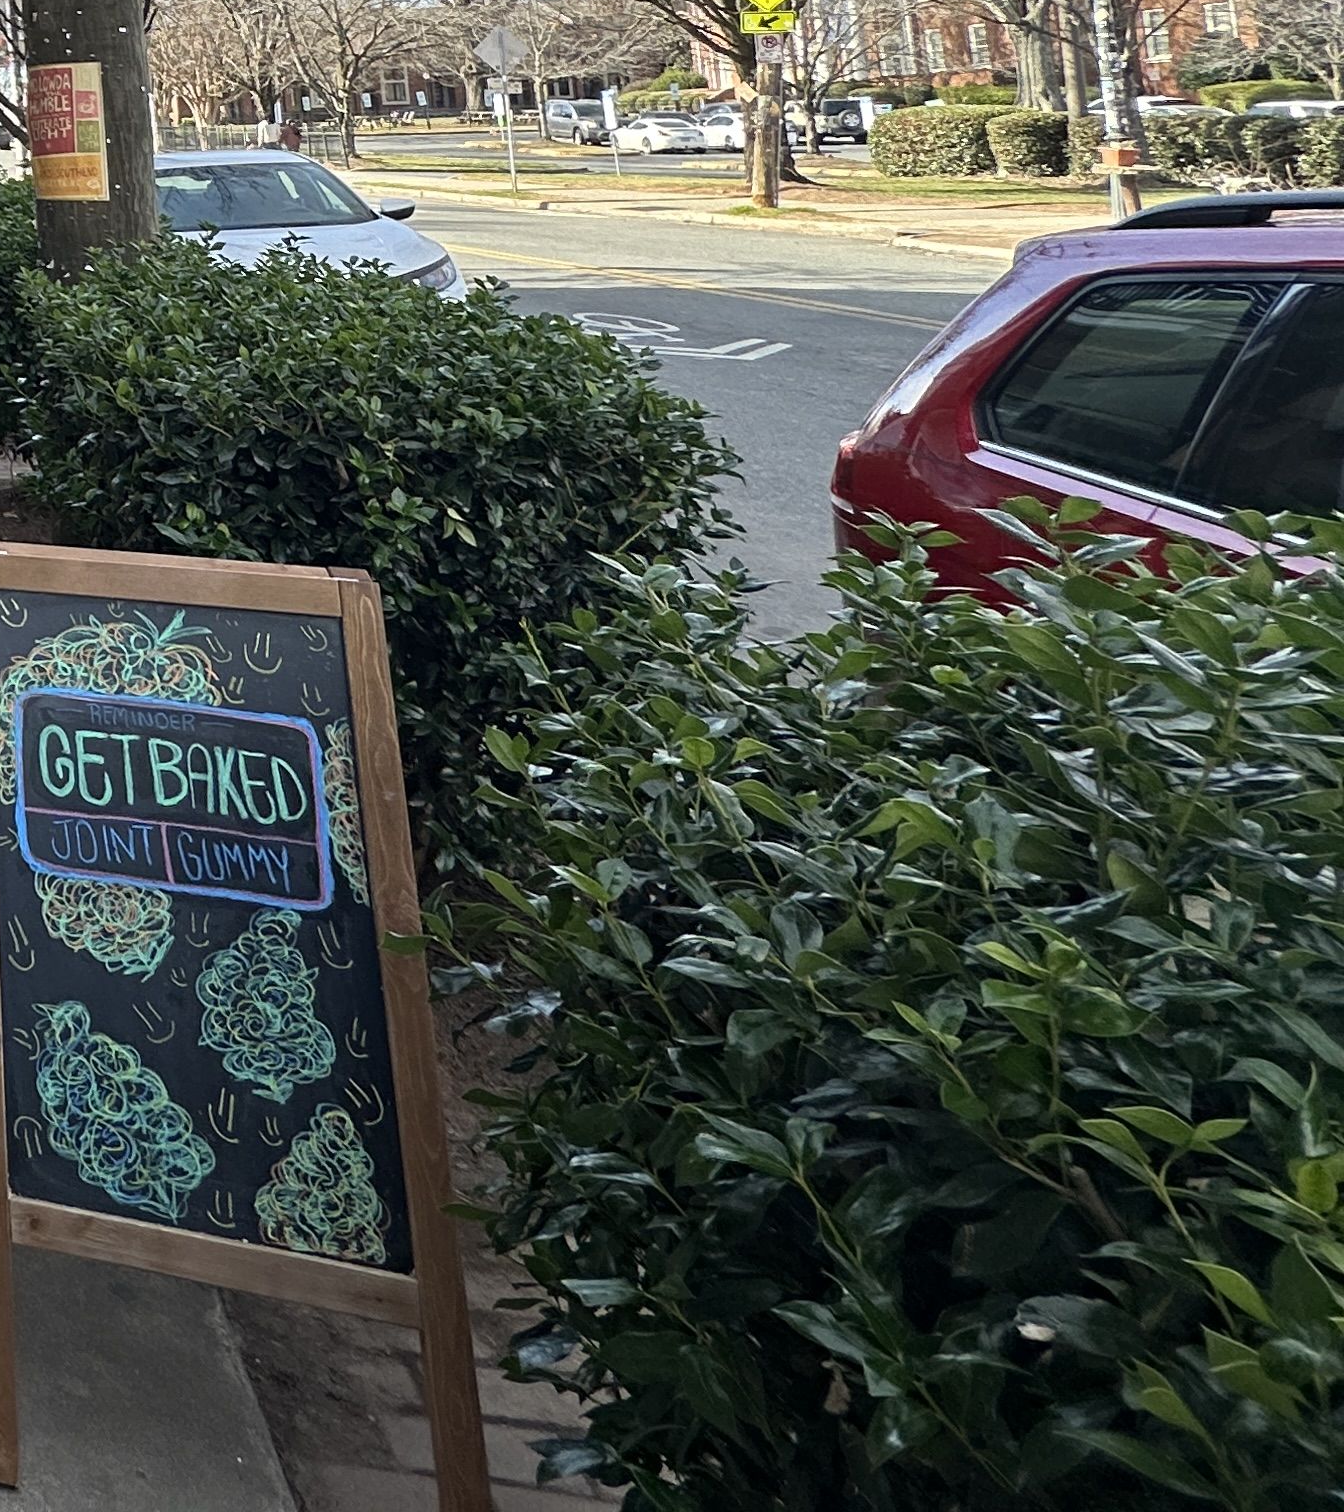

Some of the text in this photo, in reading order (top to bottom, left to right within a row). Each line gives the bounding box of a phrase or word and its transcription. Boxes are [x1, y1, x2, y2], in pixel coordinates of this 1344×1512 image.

[88, 703, 196, 731] REMINDER
[39, 724, 307, 825] GET BAKED
[51, 819, 154, 866] JOINT
[177, 830, 290, 894] GUMMY
